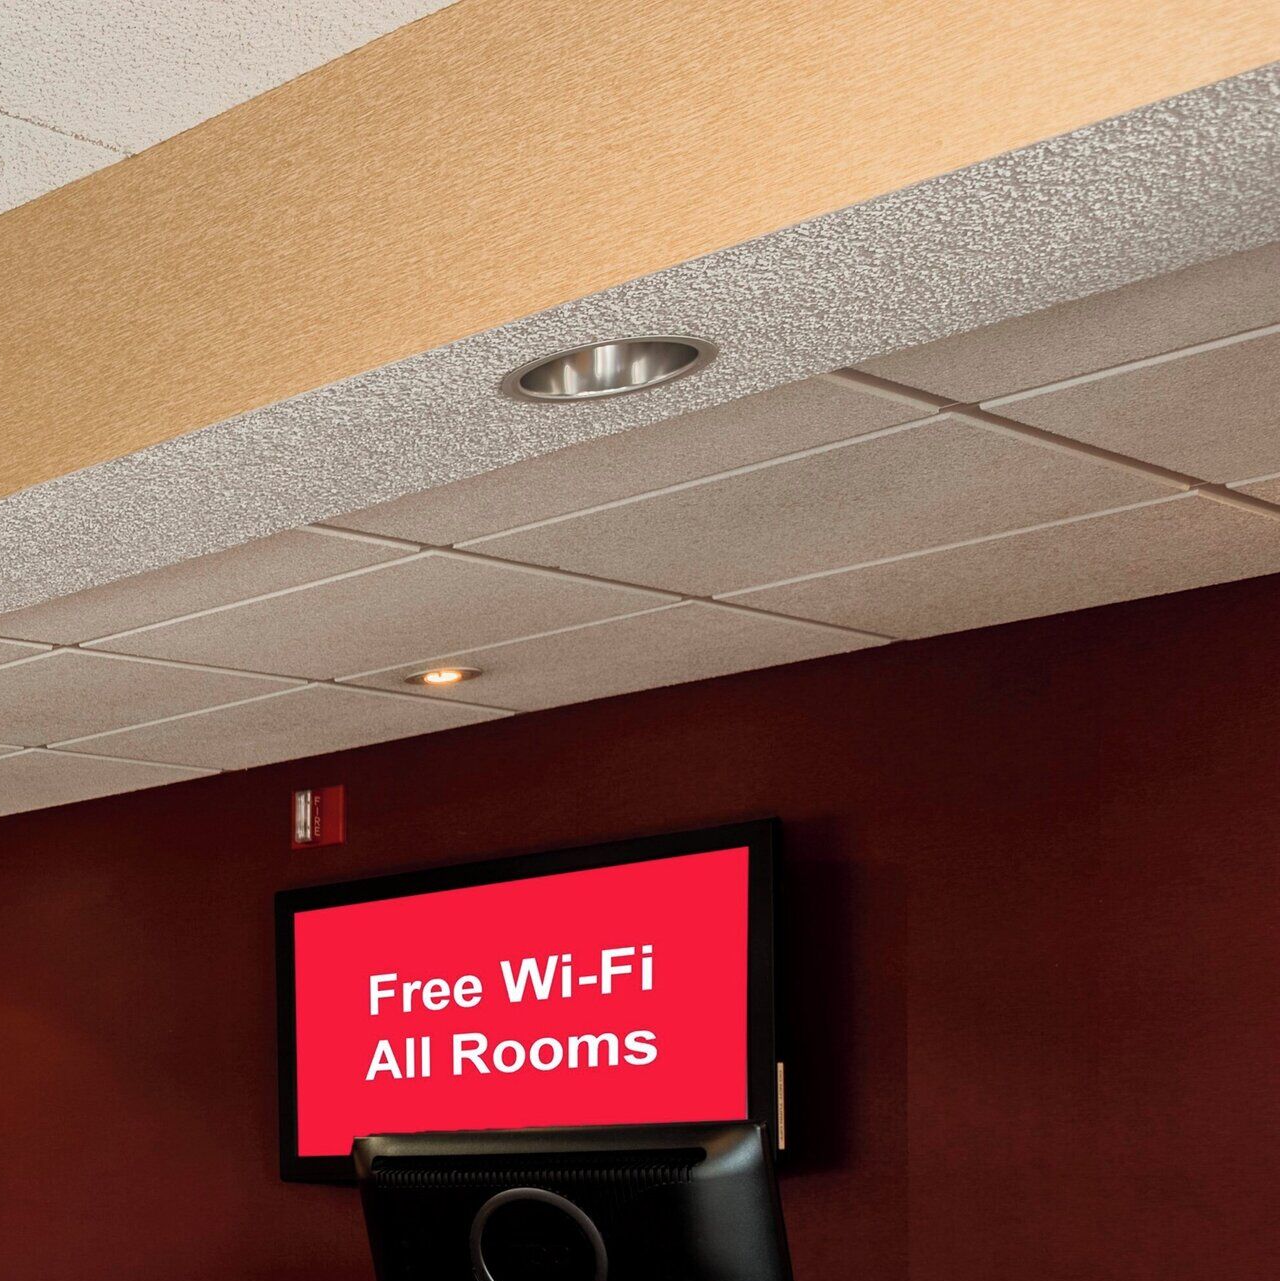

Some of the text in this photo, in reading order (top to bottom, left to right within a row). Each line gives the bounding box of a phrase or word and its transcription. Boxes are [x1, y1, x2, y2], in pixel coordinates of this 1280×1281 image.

[369, 944, 653, 1016] Free Wi-Fi
[365, 1028, 658, 1081] All Rooms
